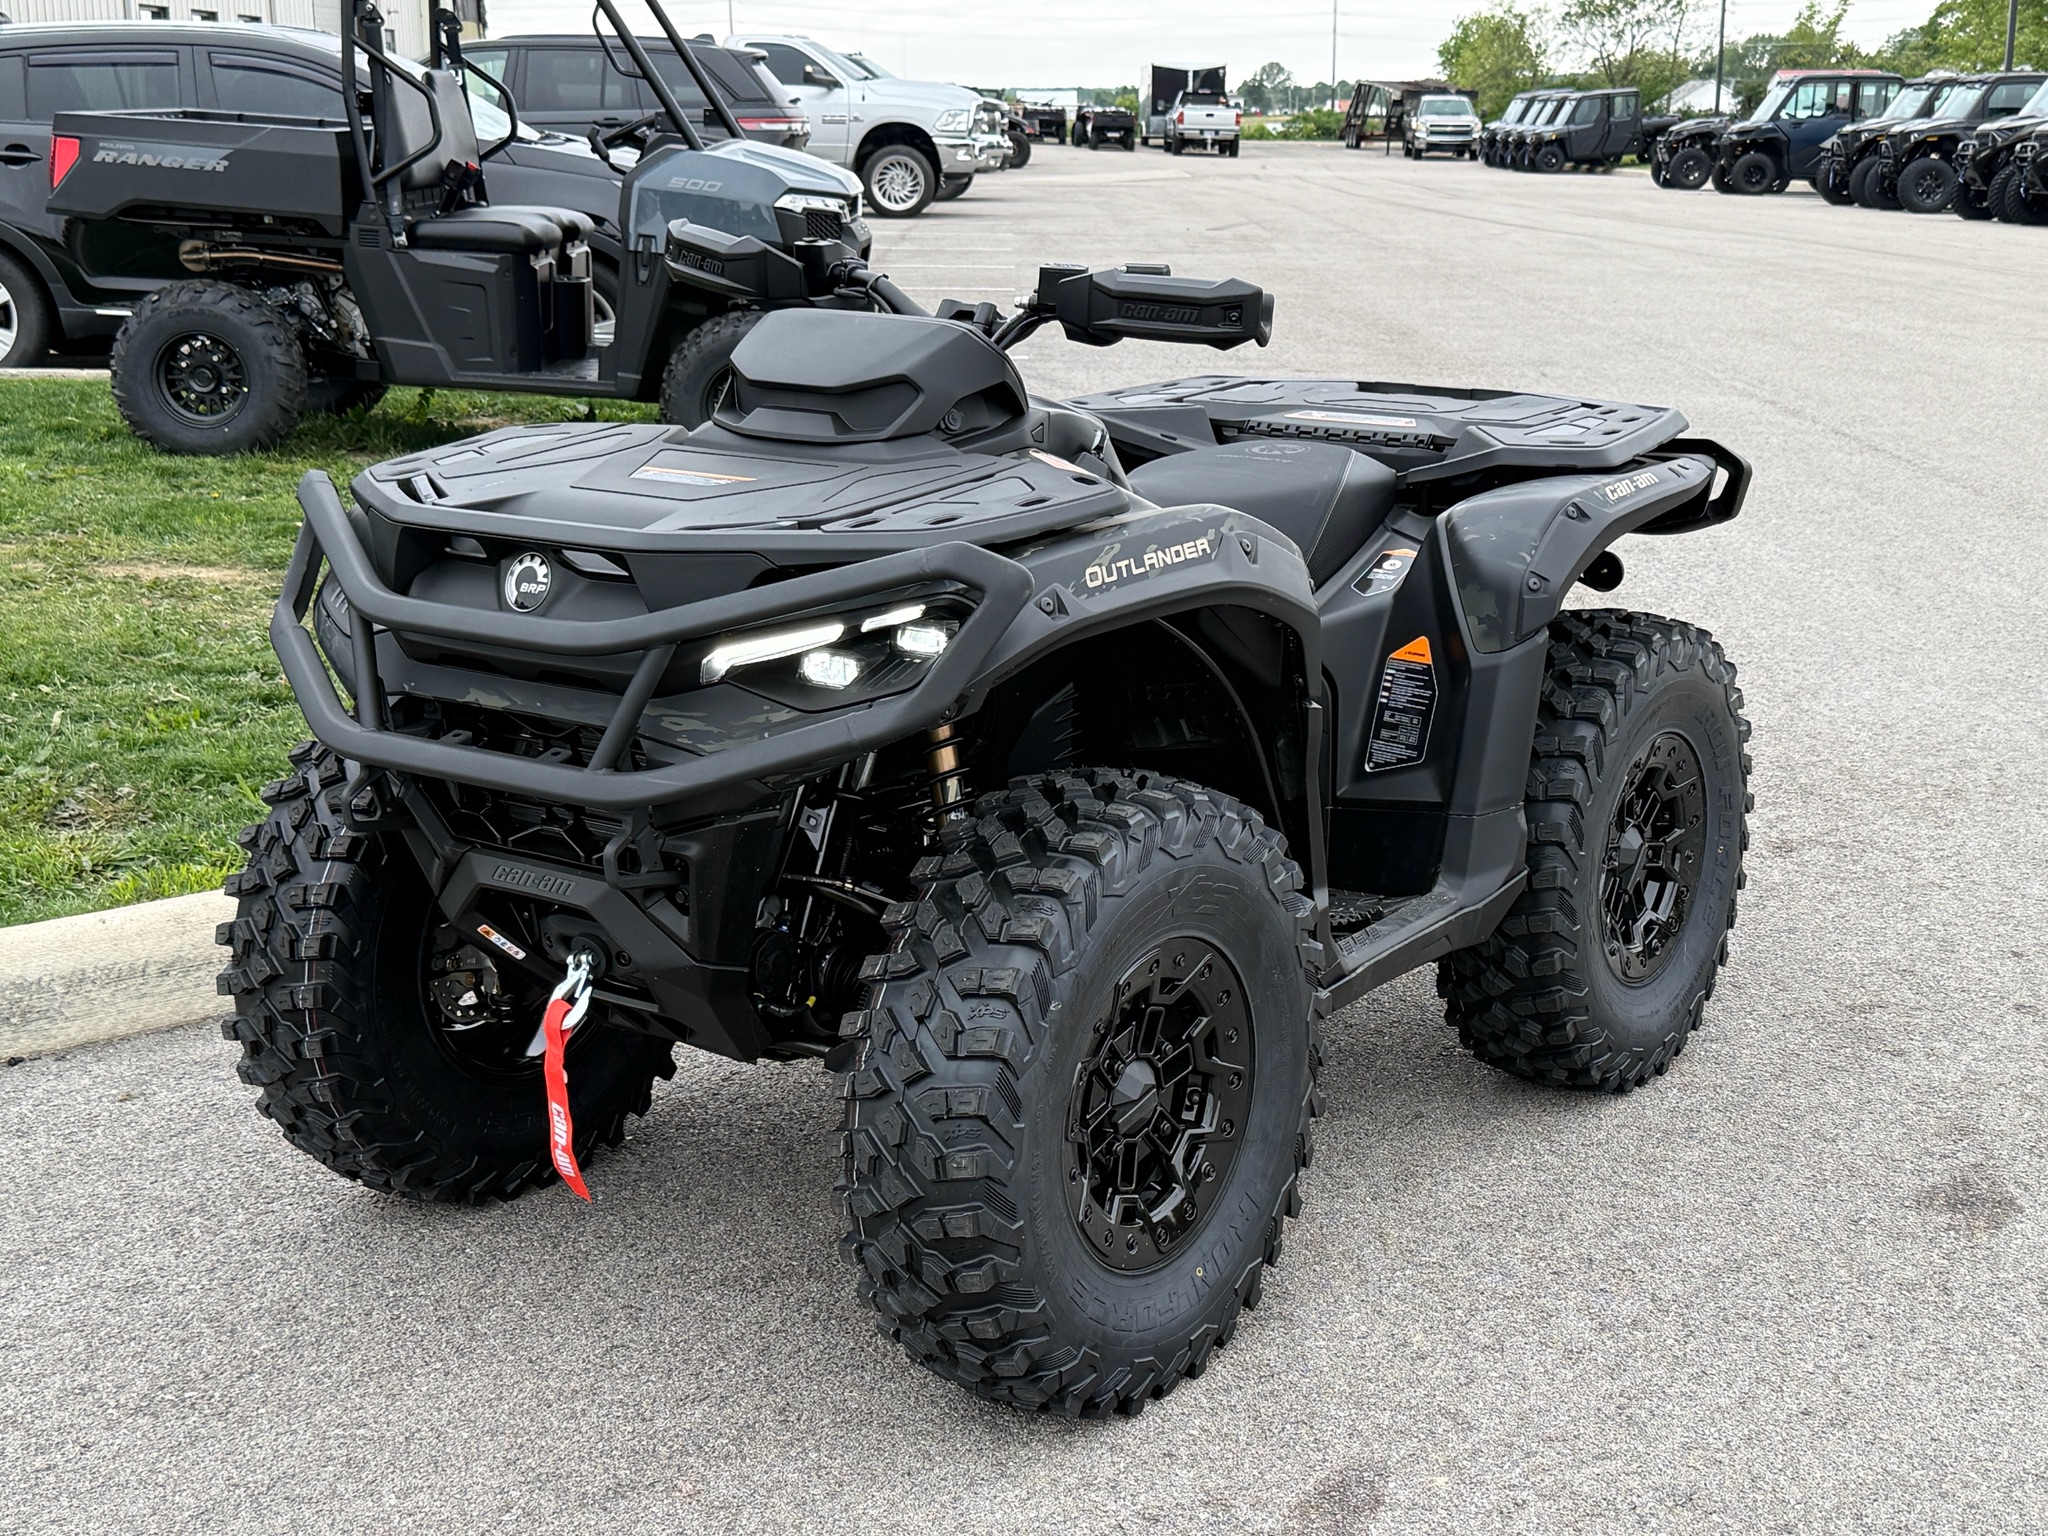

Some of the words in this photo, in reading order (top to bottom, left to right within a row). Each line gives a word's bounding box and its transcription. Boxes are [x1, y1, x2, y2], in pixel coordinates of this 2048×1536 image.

[93, 149, 230, 173] RANGER
[667, 176, 723, 193] 500
[679, 249, 724, 275] can-am
[1118, 303, 1201, 324] can-am
[1604, 471, 1660, 501] can-am
[1085, 537, 1212, 589] OUTLANDER
[519, 582, 547, 595] BRP
[492, 864, 577, 897] can-am
[551, 1100, 577, 1178] can-am
